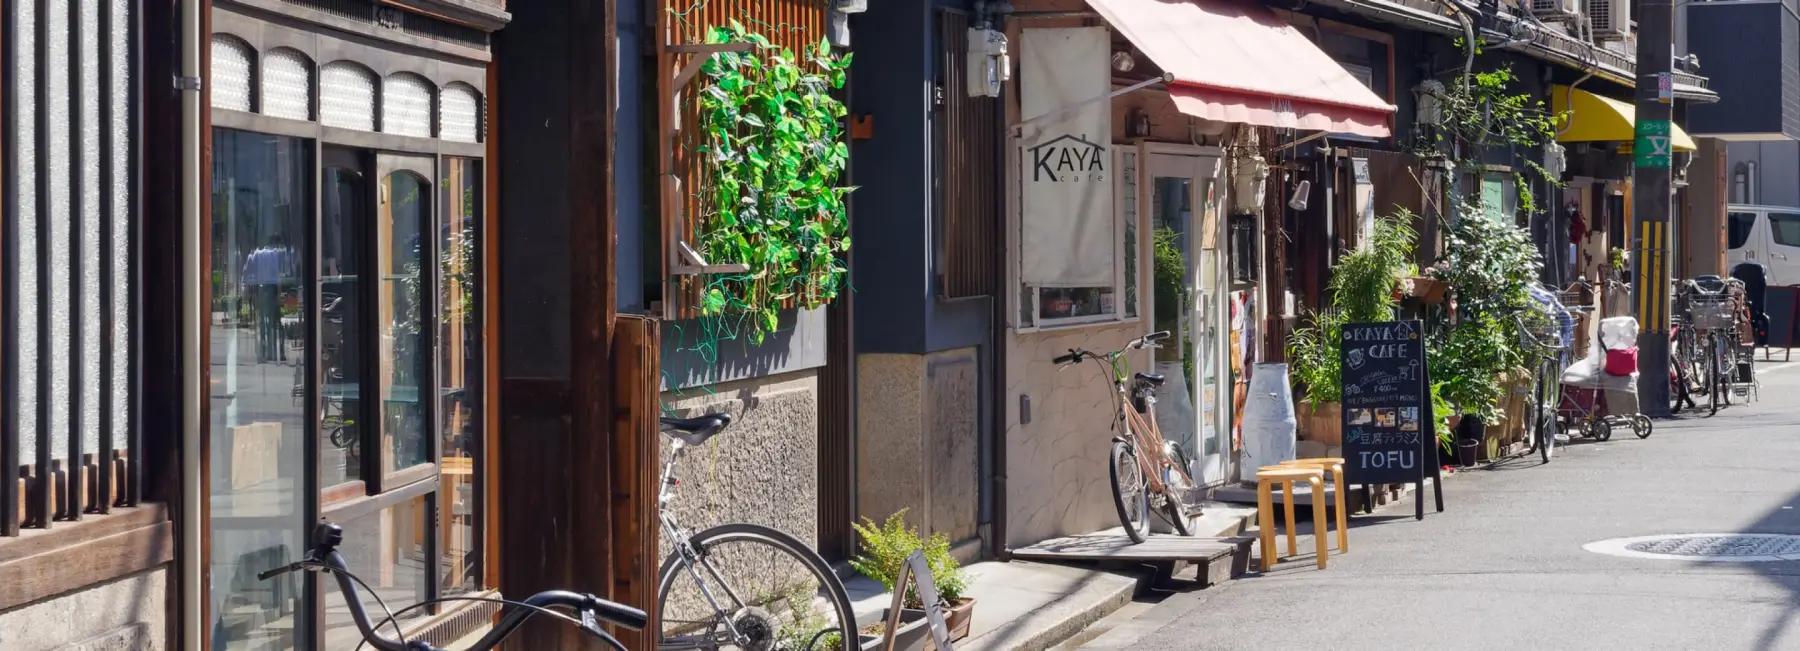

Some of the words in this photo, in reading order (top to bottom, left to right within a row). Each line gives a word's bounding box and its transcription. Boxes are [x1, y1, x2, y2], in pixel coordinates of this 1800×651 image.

[1034, 147, 1103, 182] KAYA
[1060, 173, 1103, 182] cafe
[1354, 327, 1394, 341] KAYA
[1368, 344, 1408, 359] CAFE
[1360, 432, 1421, 445] 豆腐ティラミス
[1359, 450, 1414, 469] TOFU
